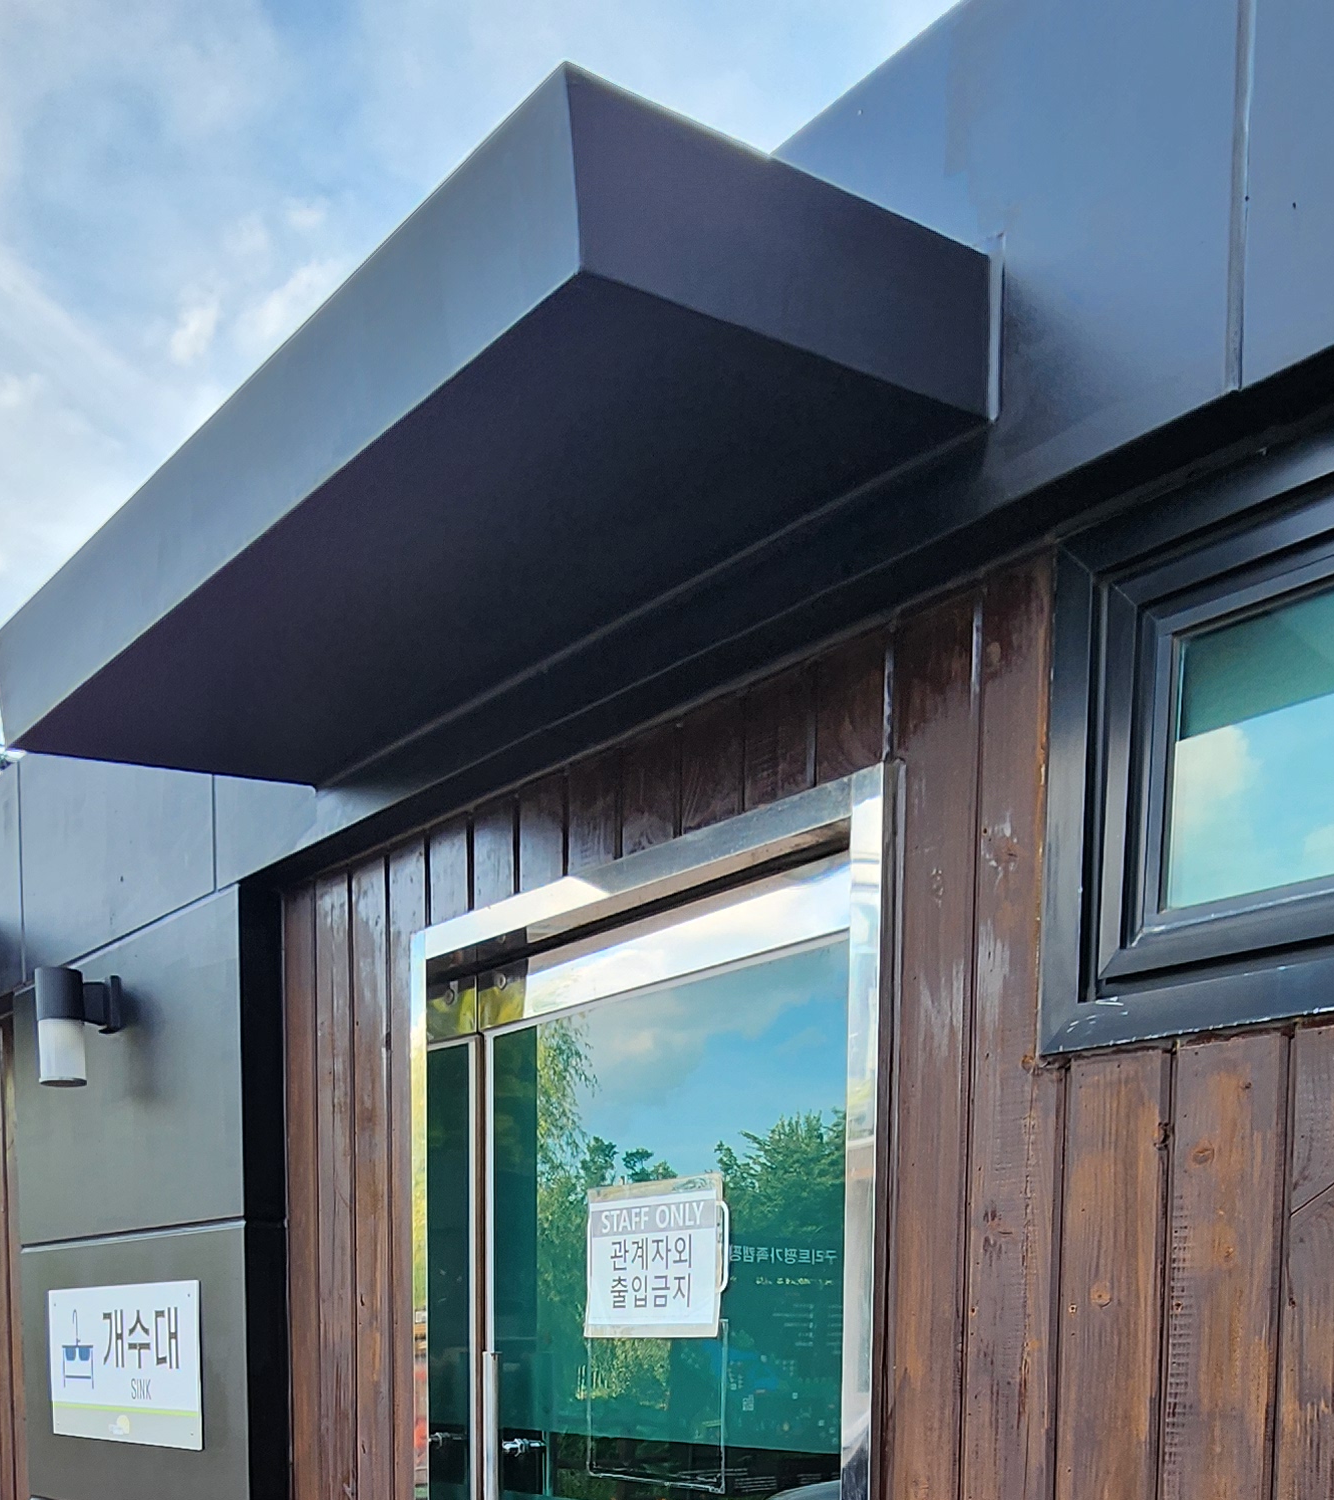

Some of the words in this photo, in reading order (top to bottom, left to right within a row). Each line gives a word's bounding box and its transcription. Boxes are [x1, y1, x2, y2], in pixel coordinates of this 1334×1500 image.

[601, 1206, 650, 1234] STAFF
[655, 1201, 705, 1229] ONLY
[610, 1233, 692, 1271] 관계자외
[610, 1272, 691, 1309] 출입금지
[102, 1306, 180, 1370] 개수대
[130, 1378, 152, 1400] SINK
